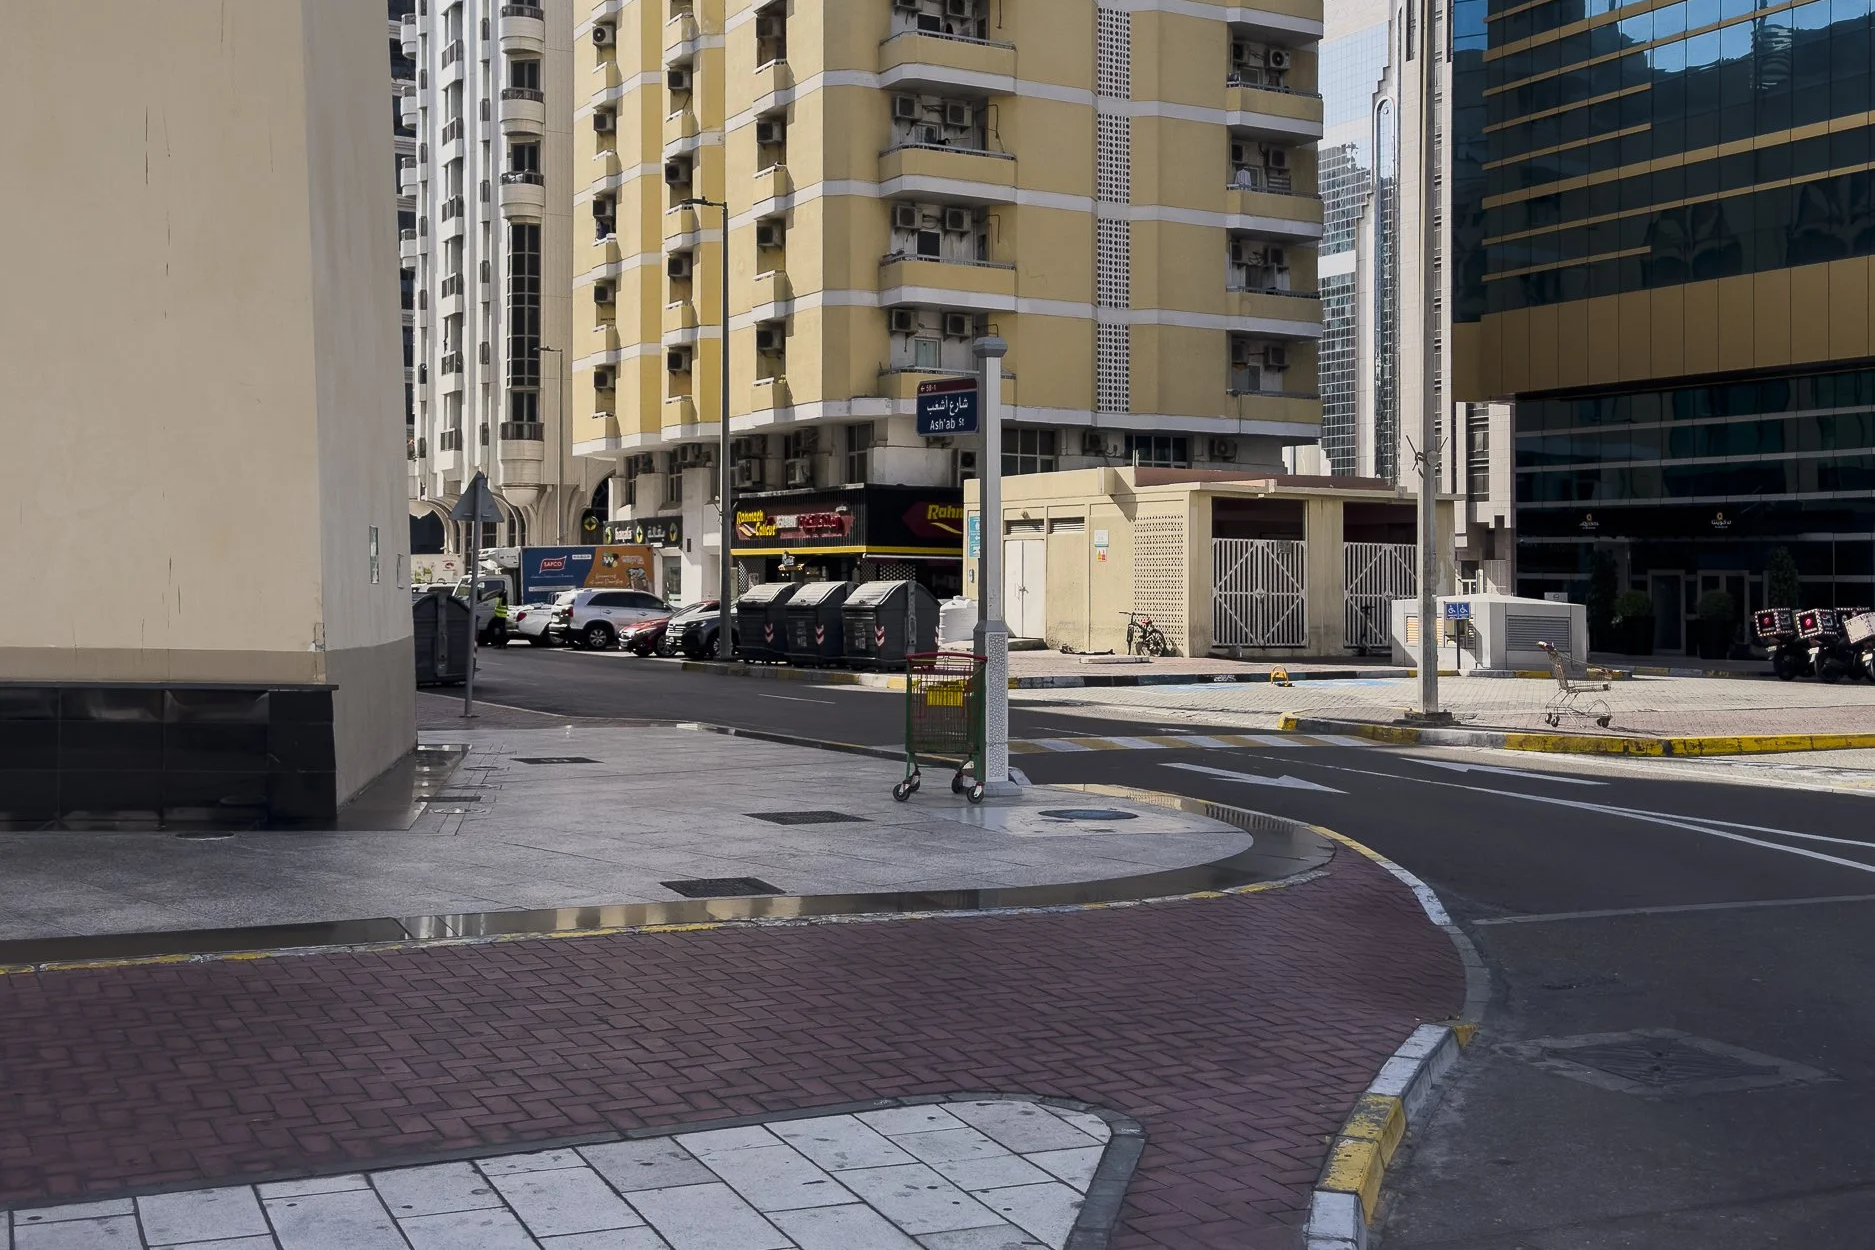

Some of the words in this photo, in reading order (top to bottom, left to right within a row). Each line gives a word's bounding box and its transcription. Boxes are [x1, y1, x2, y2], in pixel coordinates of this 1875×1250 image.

[949, 396, 968, 416] شارع
[929, 418, 956, 431] Ash'ab
[958, 417, 965, 426] St
[543, 560, 563, 568] SAFCO
